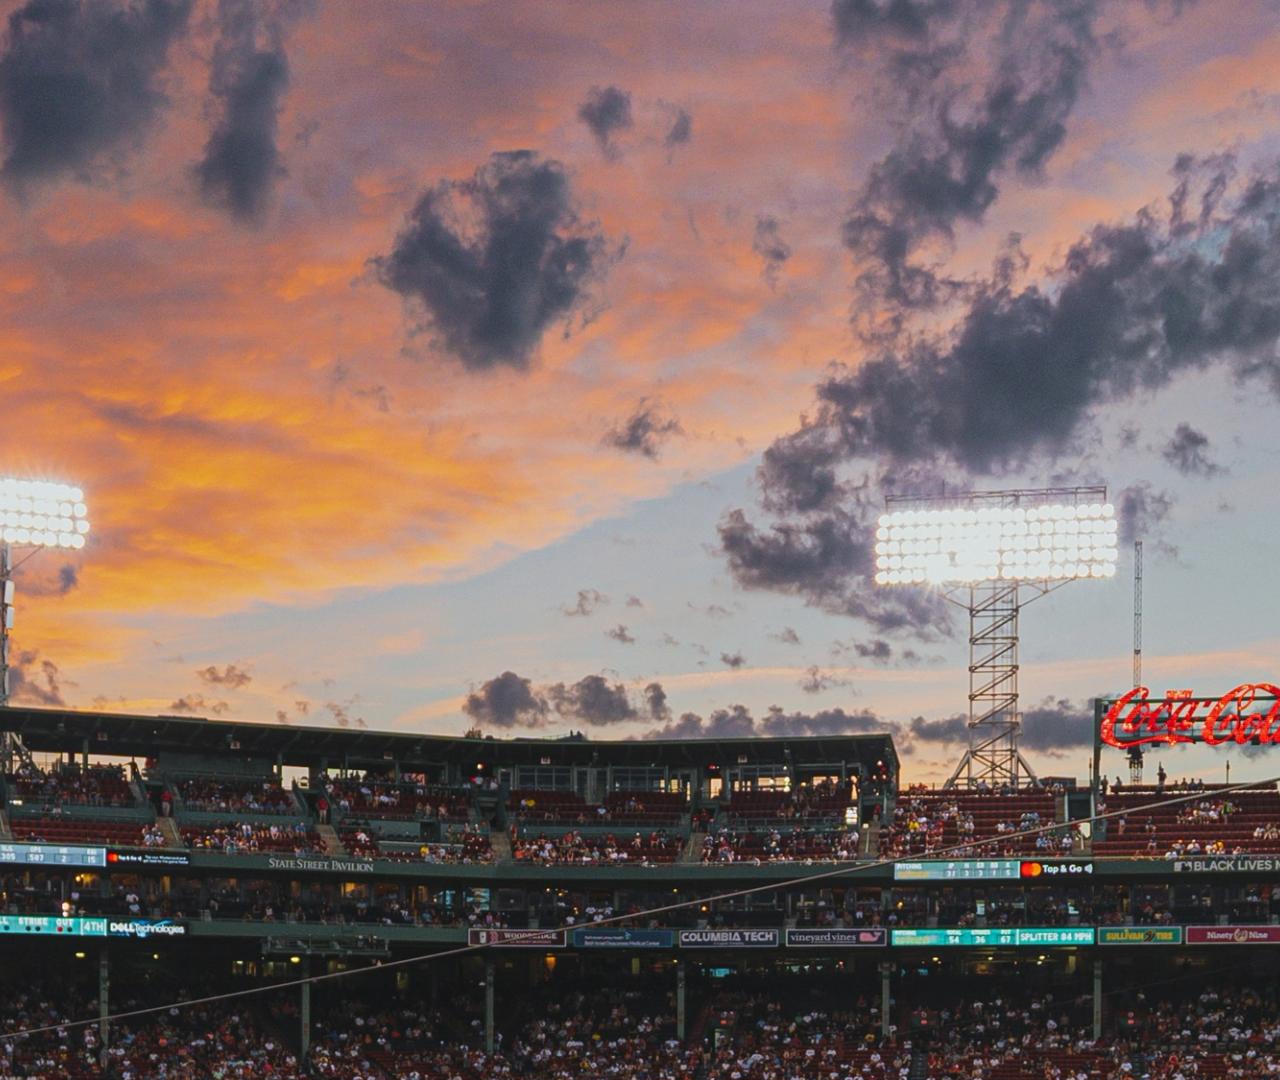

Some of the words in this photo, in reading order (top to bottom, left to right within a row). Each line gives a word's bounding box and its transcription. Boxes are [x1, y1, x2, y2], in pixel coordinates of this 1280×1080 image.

[269, 858, 295, 868] STATE
[297, 859, 329, 870] STREET
[331, 861, 374, 872] PAVILION
[1043, 865, 1058, 874] Tap
[1069, 865, 1082, 873] Go
[1194, 860, 1235, 871] BLACK
[1238, 860, 1271, 871] LIVES
[19, 917, 48, 925] STRIKE
[56, 918, 74, 926] OUT
[84, 920, 104, 931] 4TH
[681, 932, 740, 942] COLUMBIA
[743, 931, 773, 942] TECH
[790, 933, 830, 944] vineyard
[831, 932, 856, 942] vines
[1020, 933, 1058, 941] SPLITTER
[1074, 933, 1092, 941] MPH
[1207, 931, 1234, 941] Ninety
[1249, 930, 1268, 940] Nine
